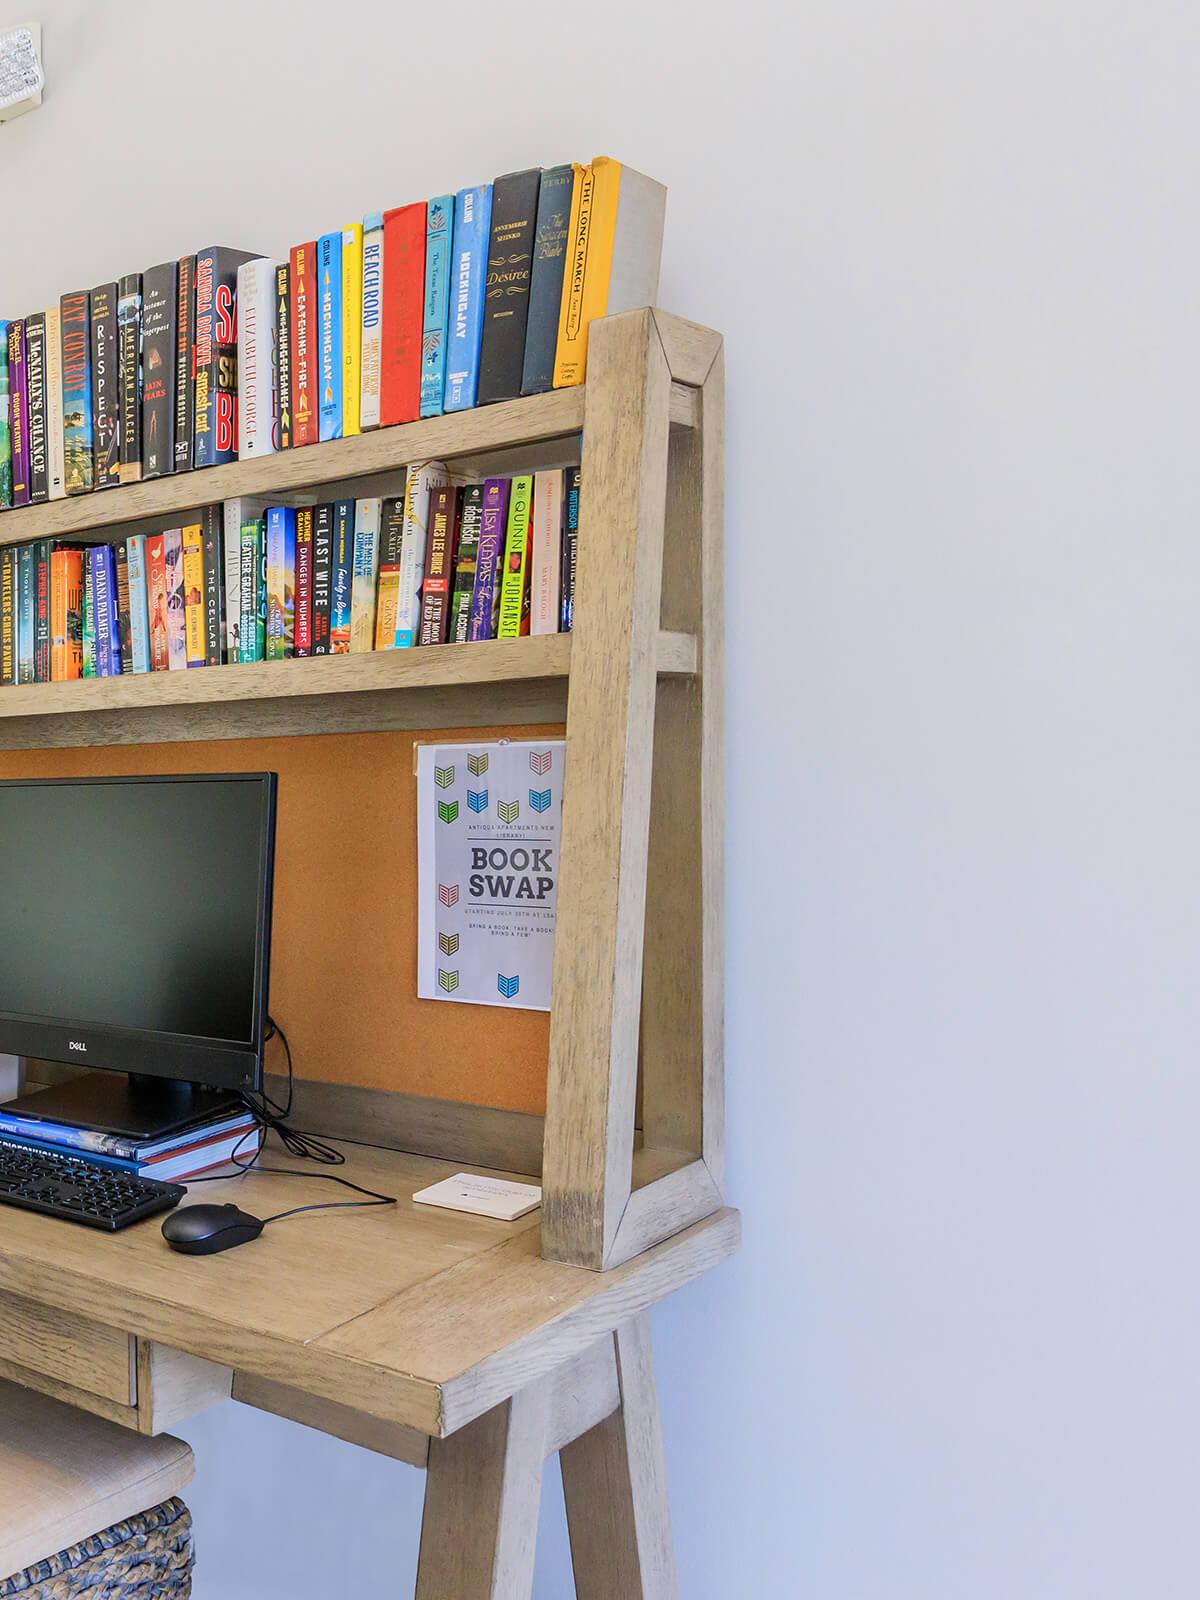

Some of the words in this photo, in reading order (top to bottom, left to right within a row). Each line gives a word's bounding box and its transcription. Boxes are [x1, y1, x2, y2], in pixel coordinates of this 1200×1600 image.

[462, 193, 473, 224] COLLINS
[582, 181, 591, 205] THE
[577, 210, 589, 246] LONG
[296, 249, 305, 276] COLLINS
[363, 244, 380, 291] BEACH
[573, 251, 584, 293] MARCH
[196, 257, 213, 315] SANDRA
[278, 269, 287, 296] COLLINS
[455, 252, 472, 339] MOCKINGJAY
[62, 294, 86, 322] PAT
[363, 291, 380, 329] ROAD
[196, 315, 212, 366] BROWN
[297, 295, 306, 357] CATCHING
[323, 292, 333, 381] MOCKINGJAY
[126, 327, 135, 390] AMERICAN
[245, 307, 256, 382] ELIZABETH
[279, 327, 289, 372] HUNGER
[30, 340, 43, 410] McNALLY'S
[63, 332, 87, 393] CONROY
[177, 357, 187, 392] WALTER
[298, 361, 307, 390] FIRE
[12, 392, 20, 417] ROUGH
[196, 371, 212, 413] smash
[280, 374, 289, 409] GAMES
[126, 397, 135, 443] PLACES
[196, 414, 210, 434] cut
[246, 385, 257, 435] GEORGE
[13, 418, 22, 453] WEATHER
[32, 415, 45, 474] CHANCE
[319, 508, 327, 524] THE
[434, 512, 447, 537] JAMES
[461, 506, 477, 544] ROBINSON
[483, 508, 500, 531] LISA
[511, 500, 526, 549] QUINN
[568, 490, 577, 529] PATTERSON
[242, 535, 252, 575] HEATHER
[316, 529, 329, 564] LAST
[365, 532, 373, 546] THE
[388, 528, 398, 562] FOLLETT
[433, 539, 445, 551] LEE
[299, 548, 307, 584] DANGER
[364, 548, 372, 566] MEN
[364, 566, 372, 577] OF
[431, 552, 445, 575] BURKE
[479, 534, 497, 582] KLEYPAS
[2, 563, 11, 613] TRAVELERS
[38, 562, 47, 597] STEPHEN
[96, 570, 107, 600] DIANA
[241, 577, 252, 610] GRAHAM
[300, 587, 307, 597] IN
[315, 571, 328, 607] WIFE
[335, 568, 347, 593] Family
[38, 600, 47, 620] KING
[424, 605, 433, 620] RED
[425, 595, 433, 604] OF
[433, 608, 442, 621] THE
[435, 598, 442, 606] IN
[459, 593, 469, 612] FINAL
[3, 615, 11, 643] CHRIS
[97, 602, 109, 640] PALMER
[208, 600, 216, 649] CELLAR
[384, 600, 394, 636] GIANTS
[422, 621, 432, 645] PONIES
[431, 623, 440, 642] MOON
[456, 613, 469, 643] ACCOUNT
[3, 645, 12, 679] PAVONE
[471, 847, 553, 872] BOOK
[469, 874, 554, 899] SWAP
[69, 1041, 87, 1051] DELL
